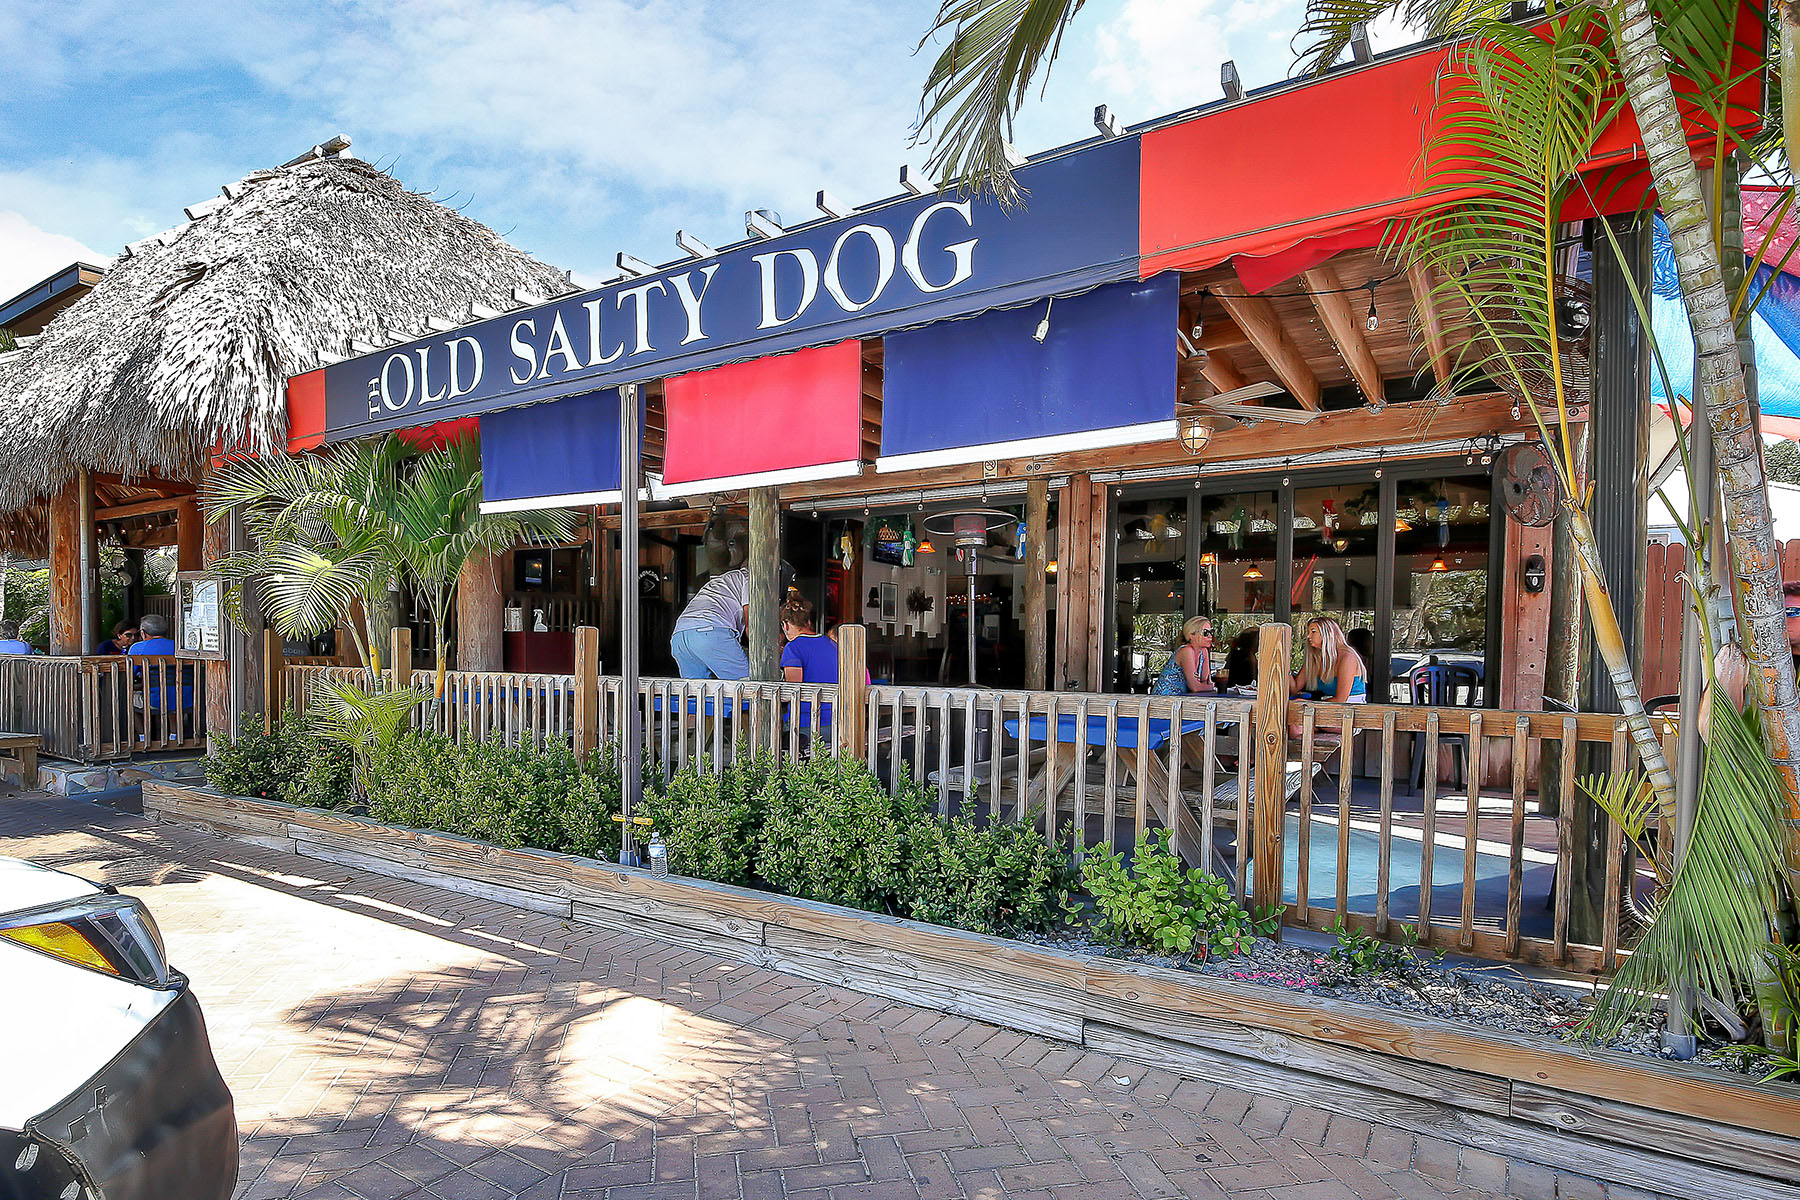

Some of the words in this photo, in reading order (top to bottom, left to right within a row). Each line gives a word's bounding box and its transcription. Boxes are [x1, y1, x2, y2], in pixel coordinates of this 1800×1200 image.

[380, 335, 484, 411] OLD
[509, 262, 721, 386] SALTY
[751, 198, 979, 330] DOG
